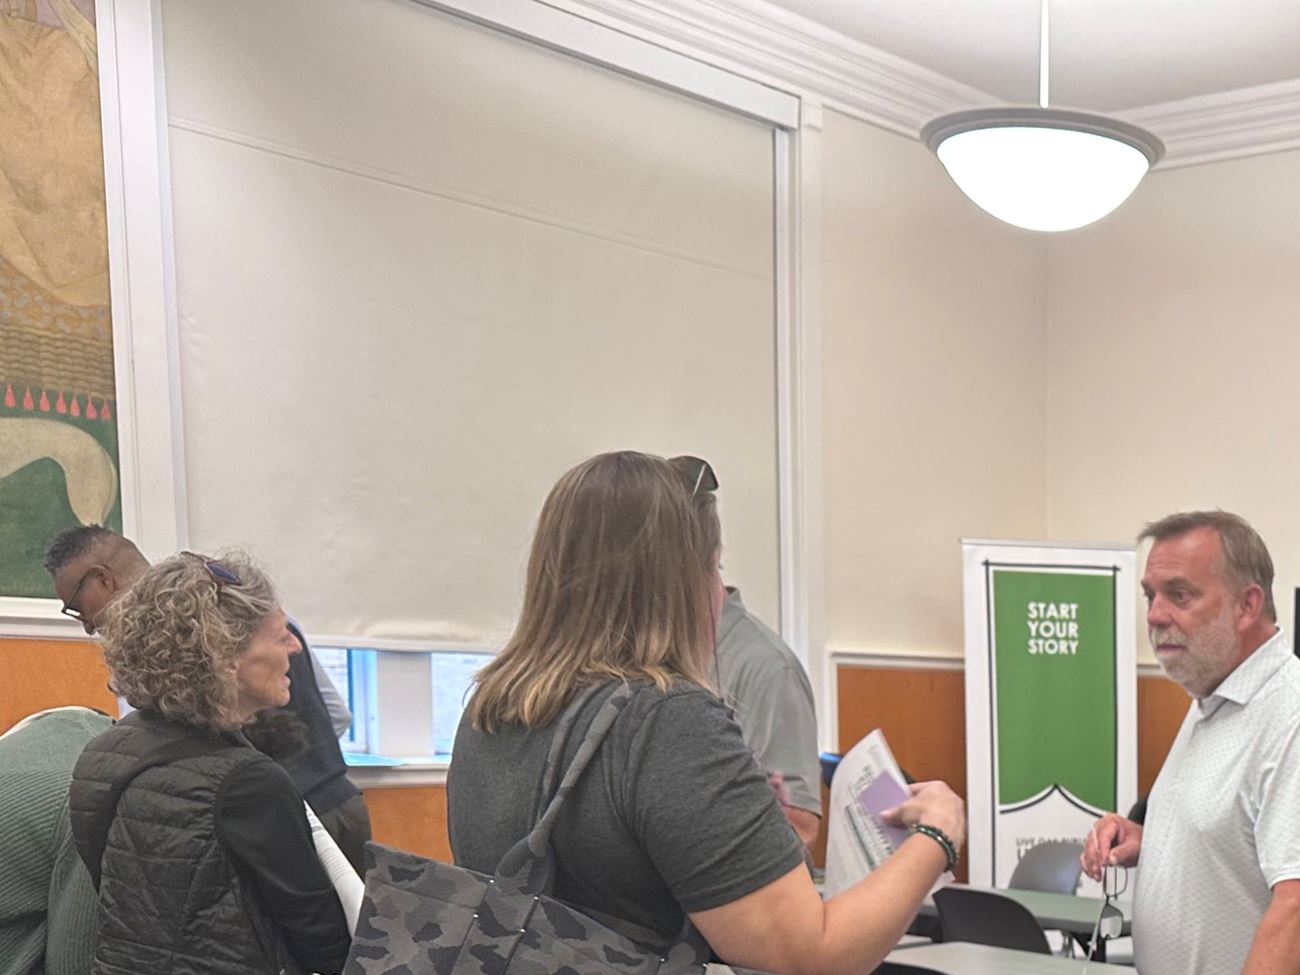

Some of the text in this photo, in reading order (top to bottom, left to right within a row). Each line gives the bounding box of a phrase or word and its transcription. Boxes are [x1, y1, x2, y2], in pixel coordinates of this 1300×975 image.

[1027, 601, 1079, 619] START
[1027, 620, 1079, 638] YOUR
[1027, 638, 1079, 656] STORY
